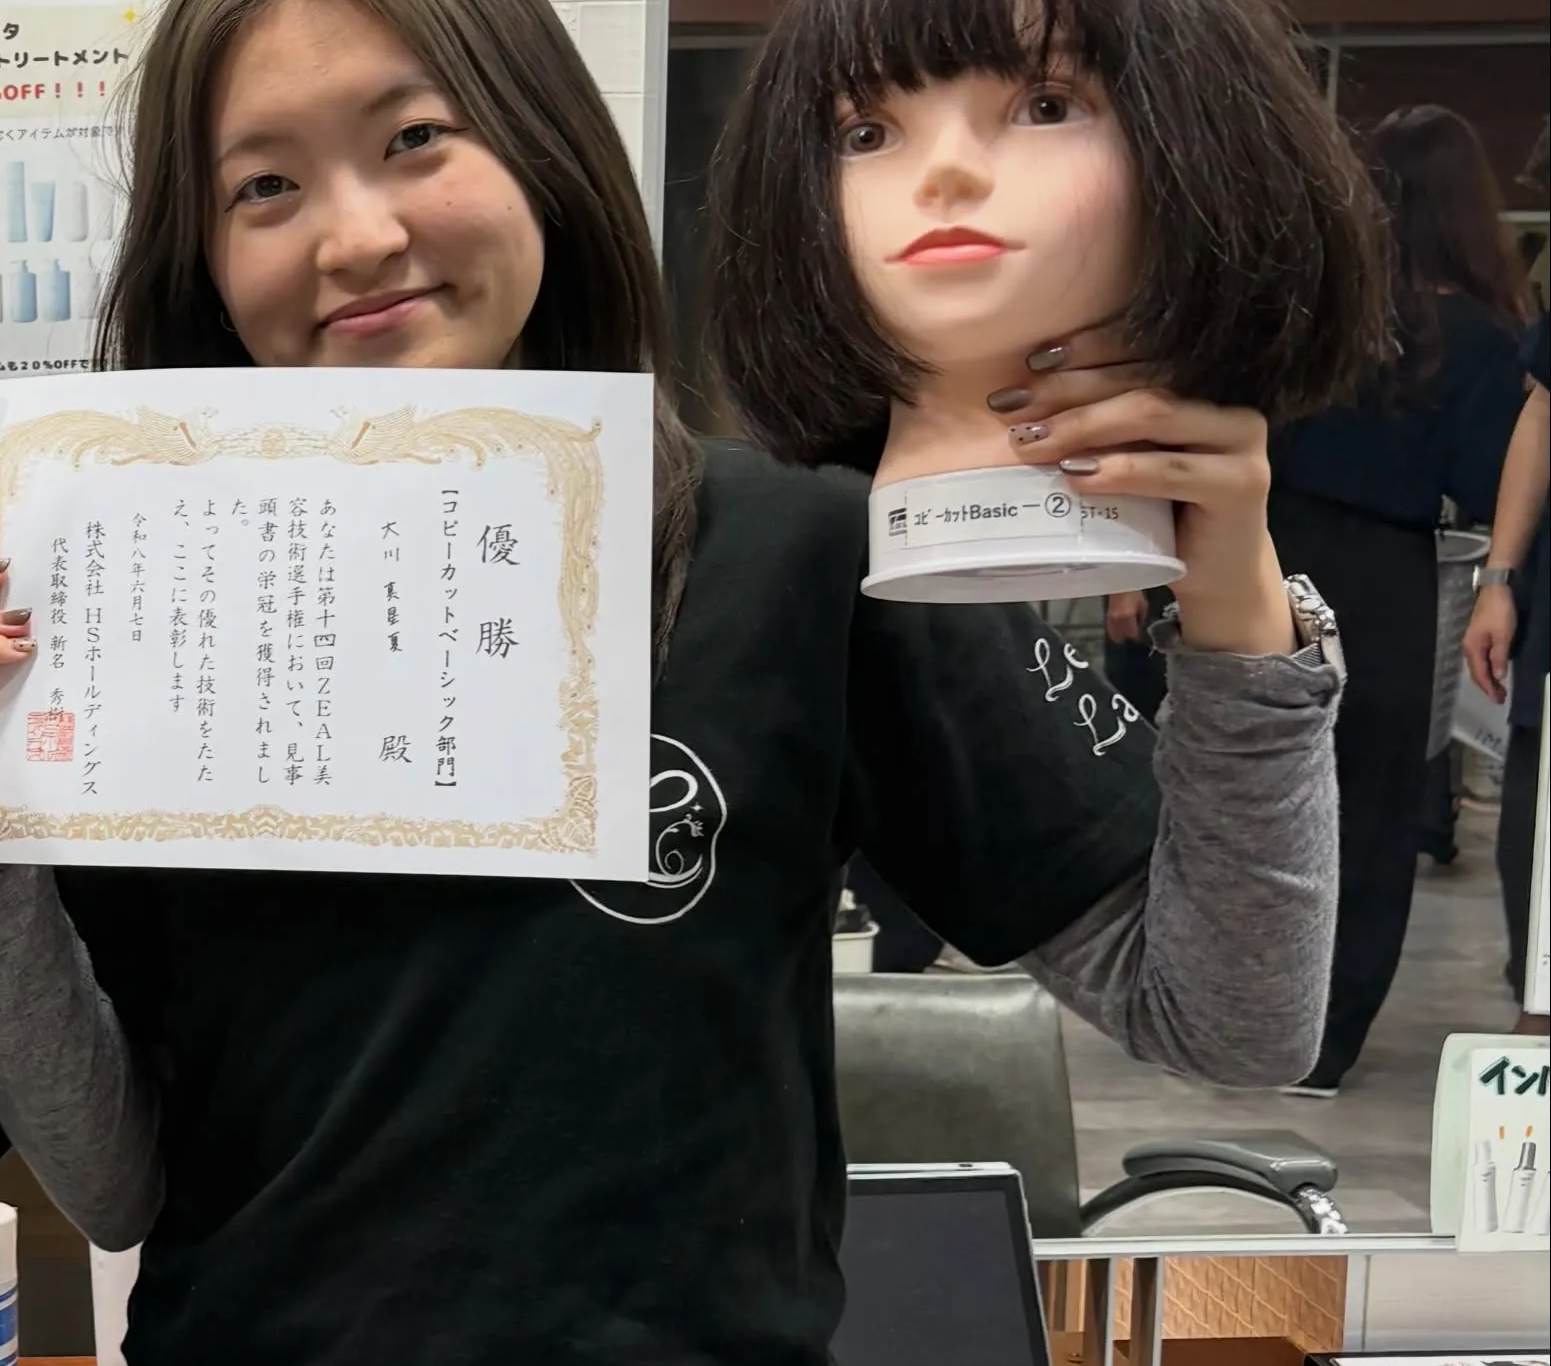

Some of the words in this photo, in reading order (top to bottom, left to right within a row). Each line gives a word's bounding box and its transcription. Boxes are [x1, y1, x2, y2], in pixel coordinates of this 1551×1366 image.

[130, 512, 147, 642] 令和八年六月七日
[195, 499, 217, 784] よってその優れた技術をたた
[255, 497, 279, 785] 頭書の栄冠を獲得されまし
